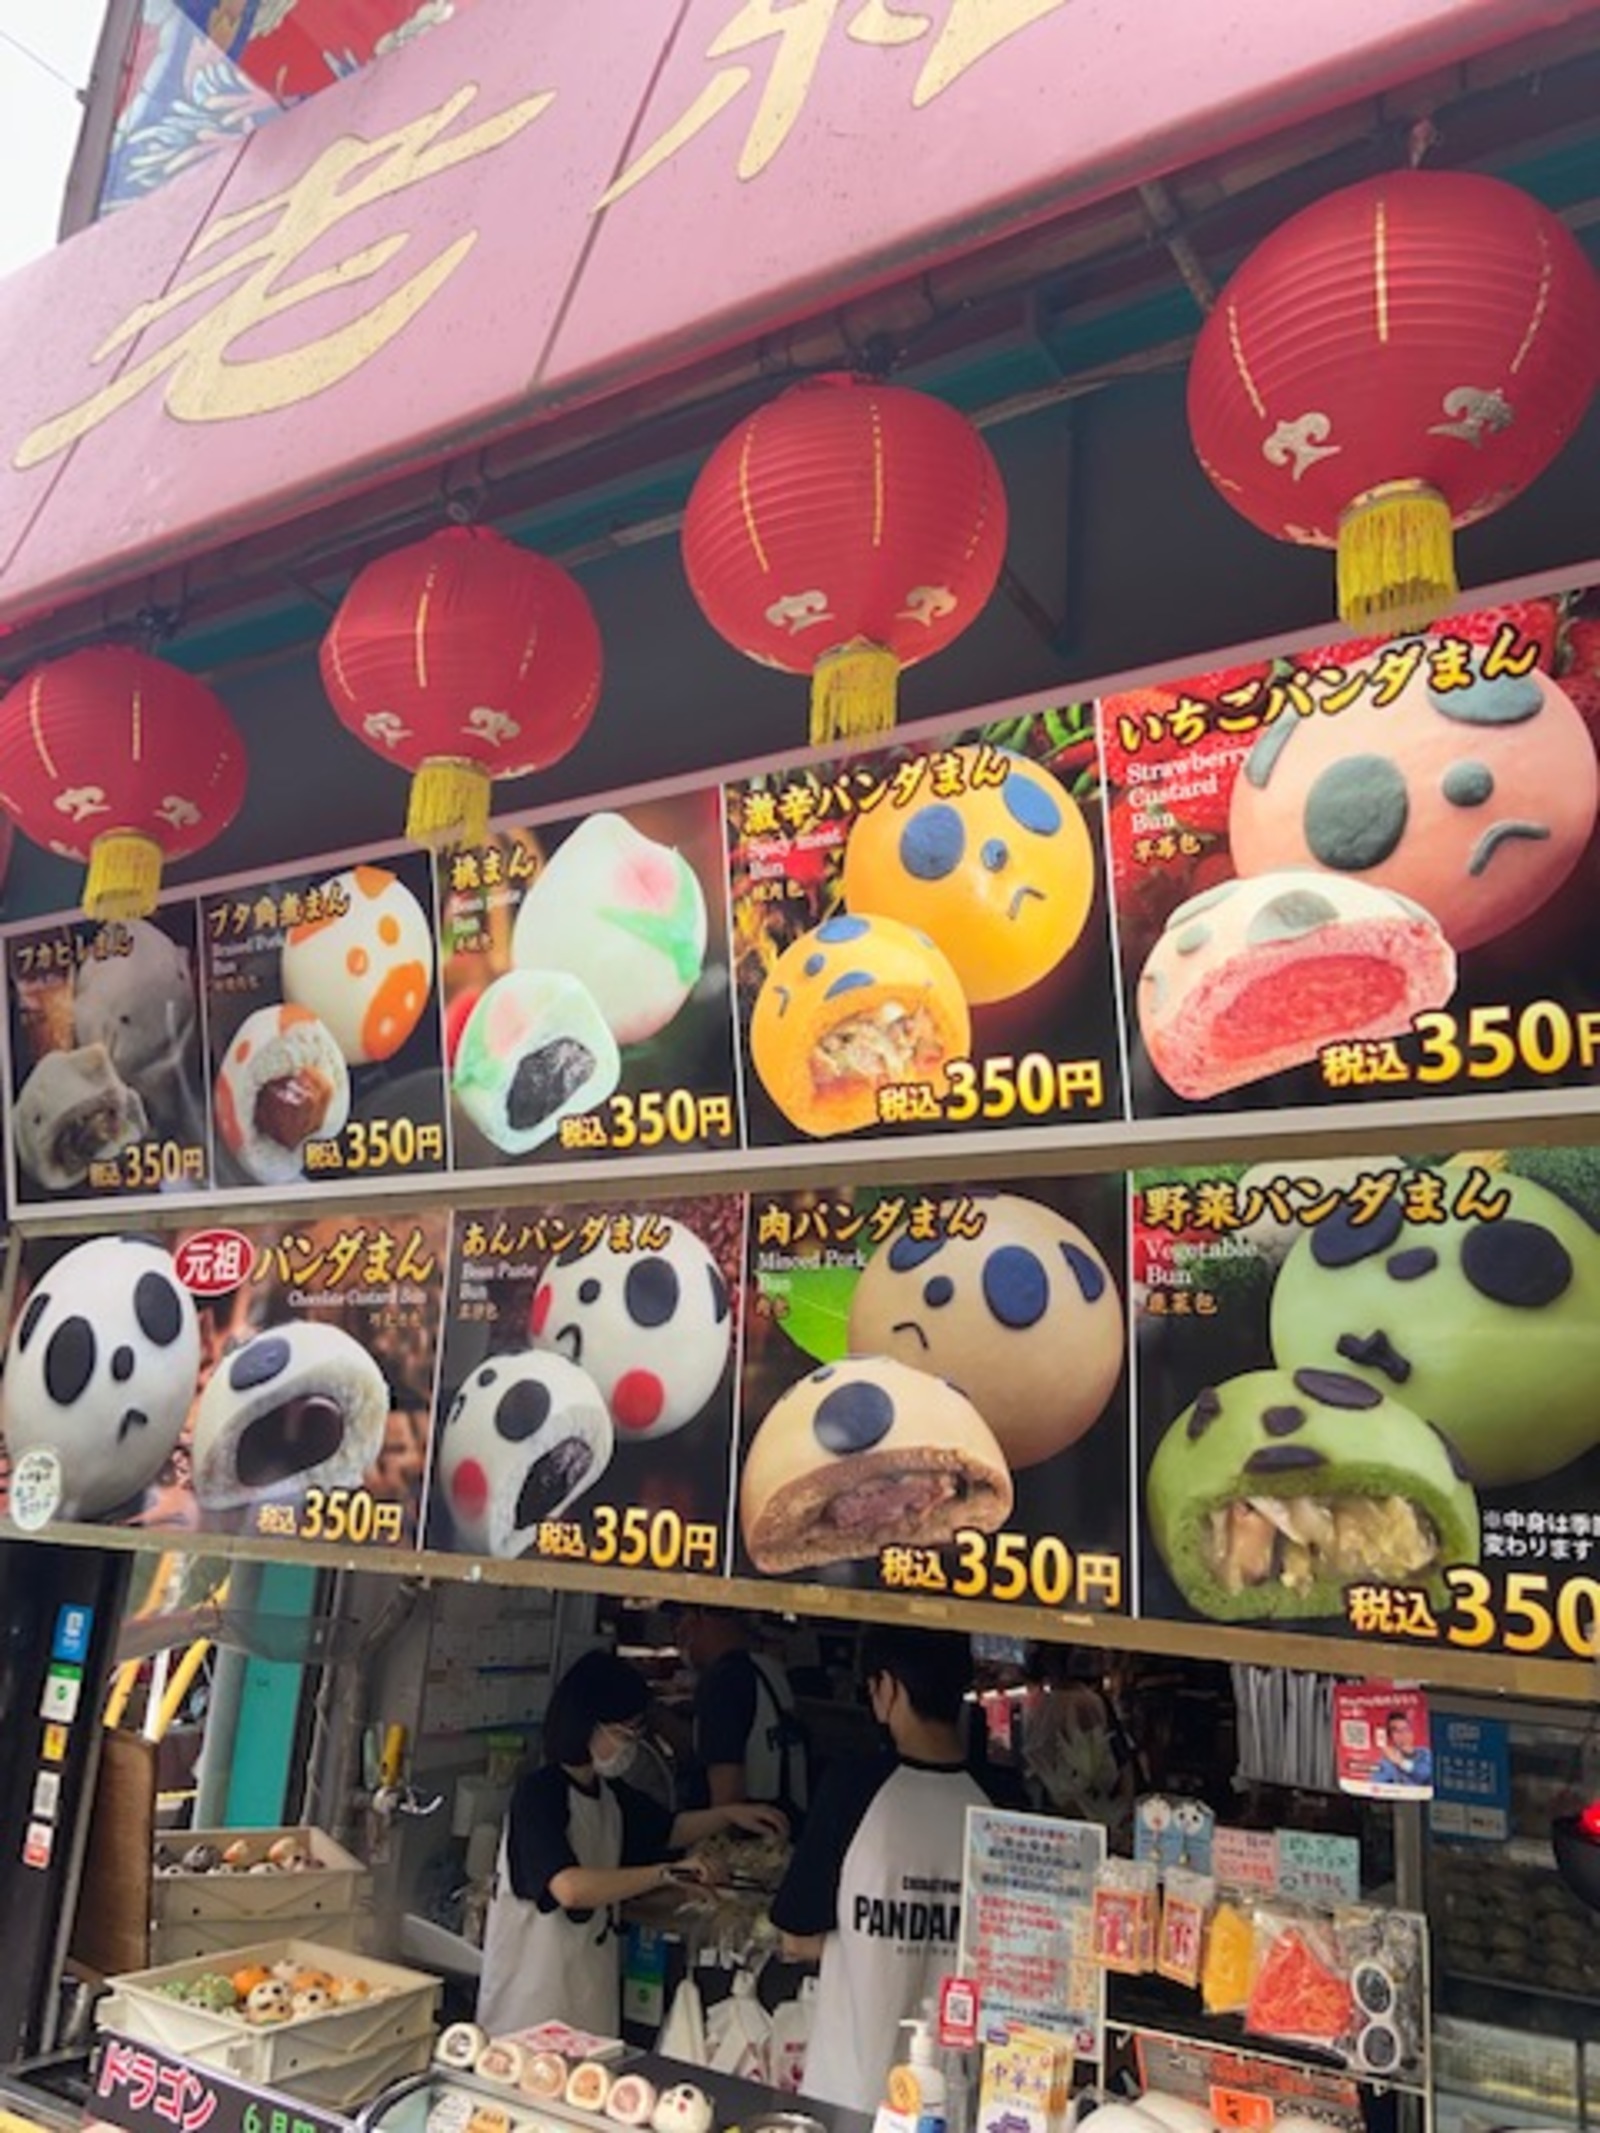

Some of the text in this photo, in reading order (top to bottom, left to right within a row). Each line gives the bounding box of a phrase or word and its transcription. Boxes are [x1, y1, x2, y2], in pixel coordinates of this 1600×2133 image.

[1118, 625, 1538, 752] いちごパンダまん
[742, 744, 1010, 836] 激辛パンダまん
[1126, 746, 1251, 784] Strawberry
[1128, 773, 1219, 808] Custard
[1132, 812, 1175, 834] Bun
[878, 1052, 1102, 1121] 税込350円
[305, 1118, 443, 1170] 税込350円
[560, 1089, 732, 1150] 税込350円
[89, 1141, 205, 1188] 税込350円
[758, 1197, 986, 1249] 肉パンダまん
[1144, 1167, 1512, 1232] 野菜パンダまん
[183, 1228, 434, 1287] 元祖 パンダまん
[462, 1213, 672, 1257] あんパンダまん
[826, 1249, 868, 1269] Pork
[1145, 1237, 1258, 1267] Vegetable
[1146, 1264, 1192, 1285] Bun
[256, 1489, 402, 1544] 税込350円
[537, 1506, 718, 1568] 税込350円
[1483, 1509, 1600, 1537] ※中身は季
[881, 1528, 1121, 1605] 税込350円
[1483, 1533, 1594, 1562] 変わります
[97, 2040, 217, 2132] ドラゴン
